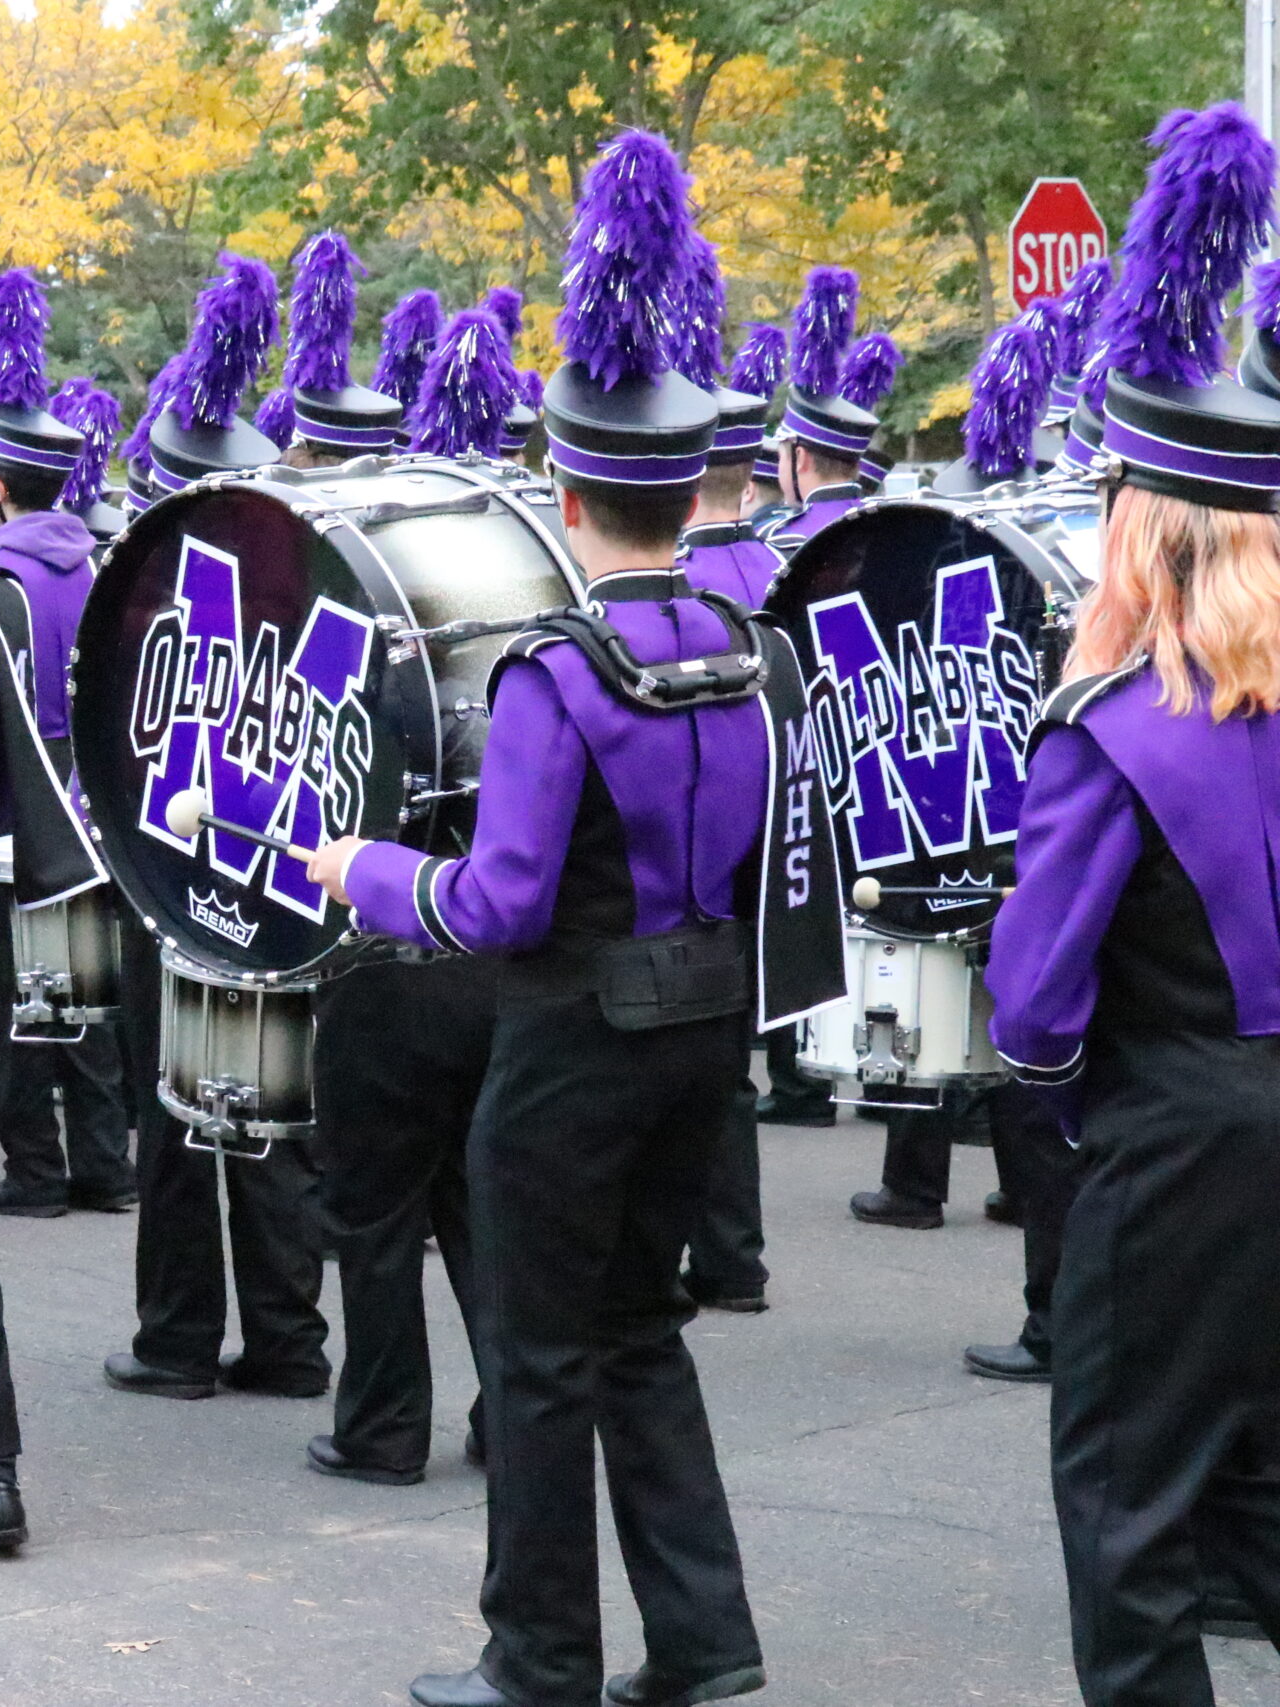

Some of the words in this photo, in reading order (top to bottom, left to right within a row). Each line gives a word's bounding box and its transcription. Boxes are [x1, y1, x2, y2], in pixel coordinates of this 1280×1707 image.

[130, 610, 237, 757] OLD
[222, 620, 374, 843] ABES
[784, 712, 817, 909] MHS
[807, 660, 898, 816] OLD
[898, 621, 1041, 782] ABES
[196, 904, 247, 941] REMO
